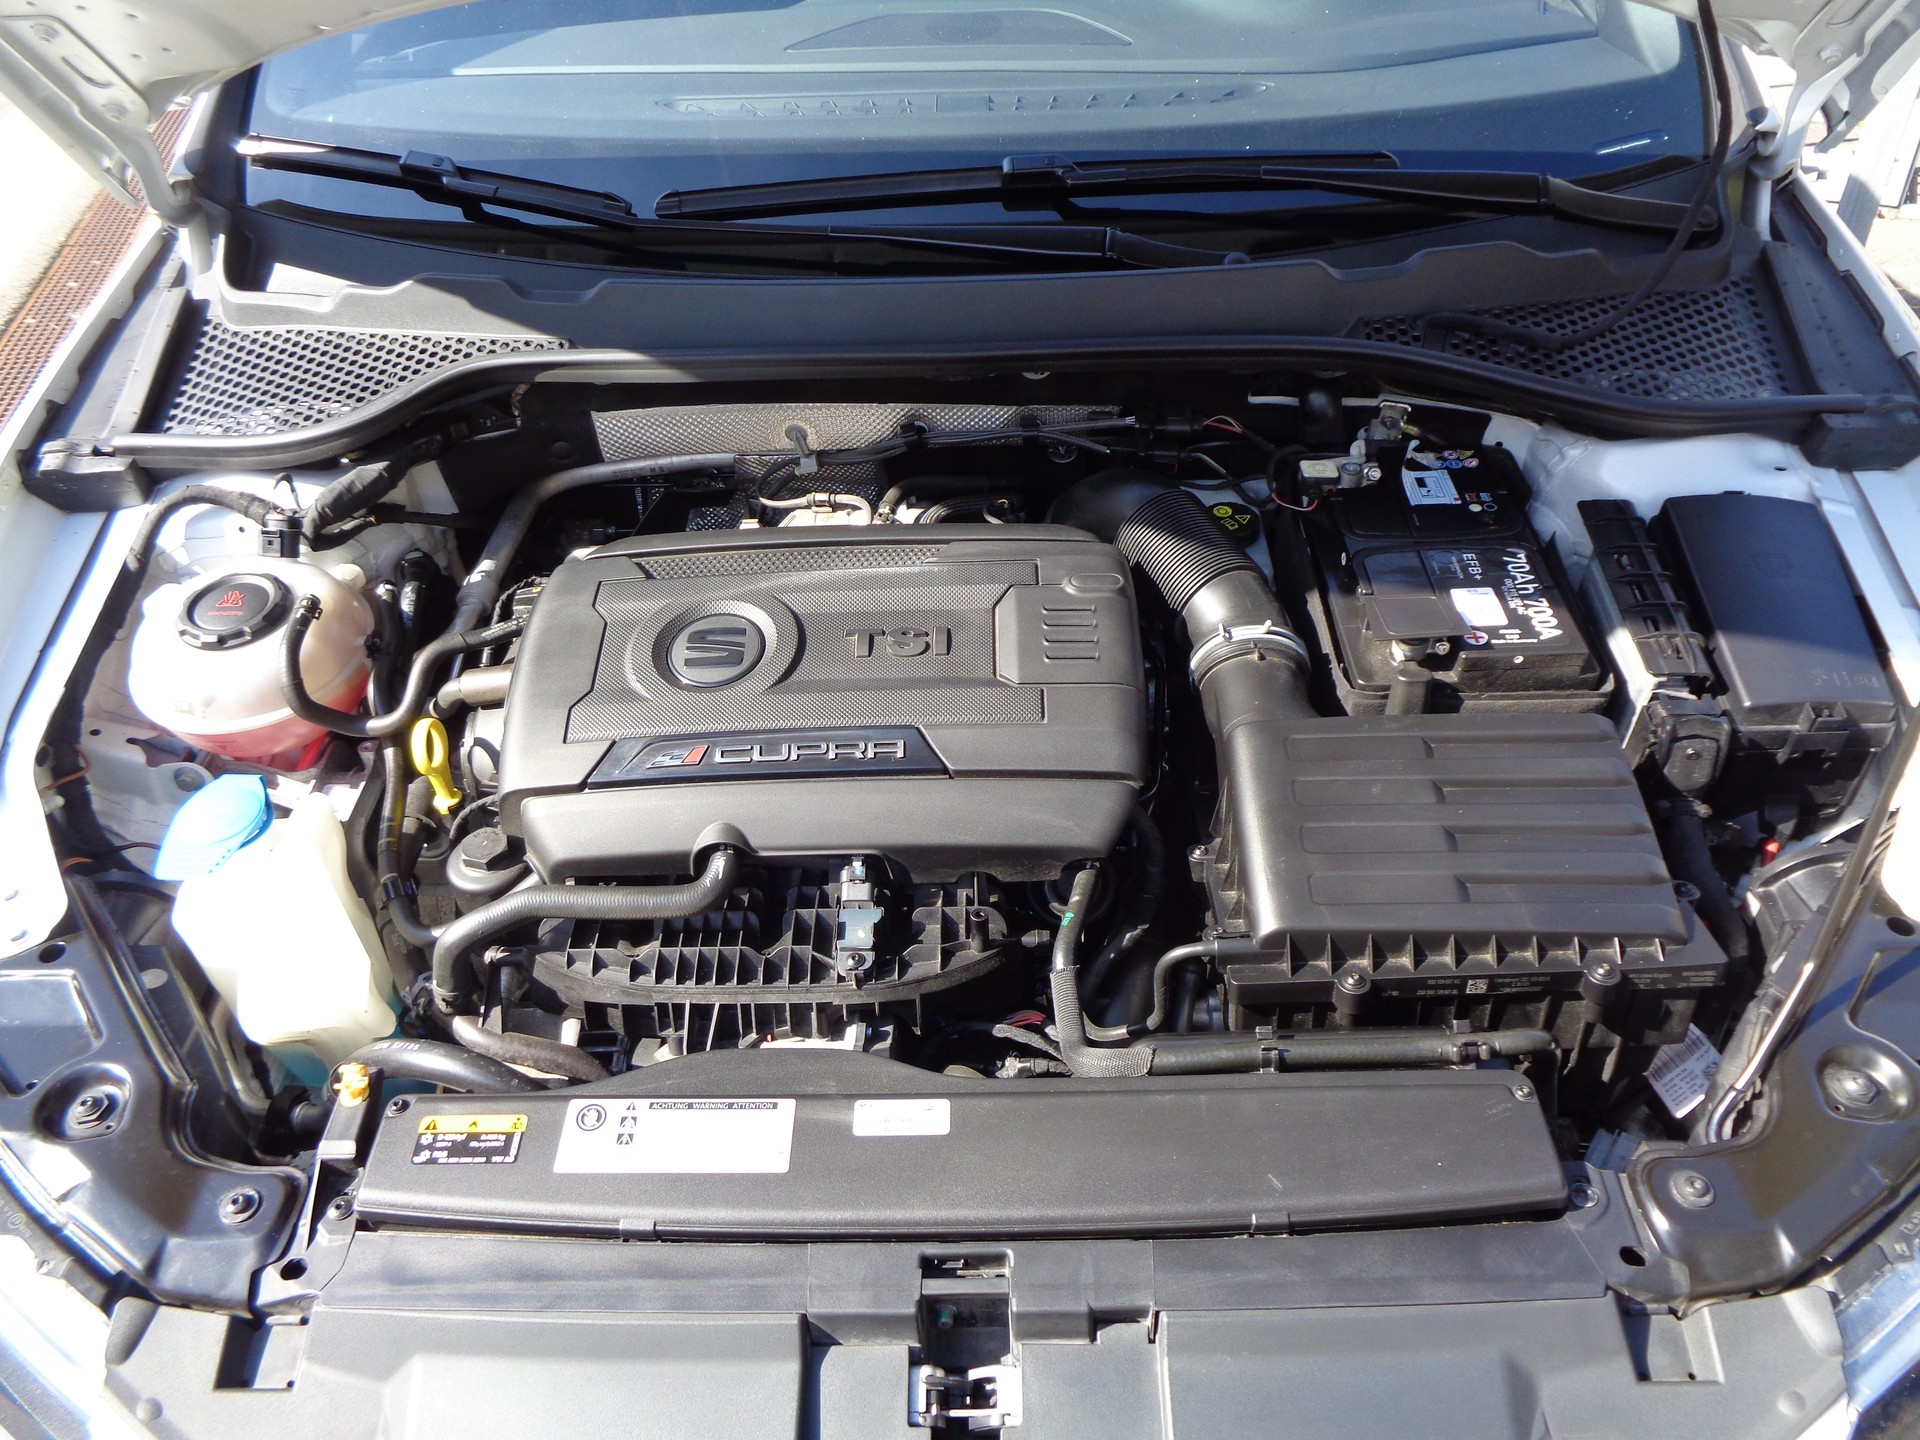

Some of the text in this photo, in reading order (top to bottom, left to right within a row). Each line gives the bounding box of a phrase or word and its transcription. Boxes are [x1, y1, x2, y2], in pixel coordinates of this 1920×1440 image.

[1462, 553, 1483, 581] EFB+
[1503, 551, 1540, 594] 70Ah
[1523, 598, 1564, 640] 700A
[844, 625, 952, 659] TSI
[715, 739, 907, 764] CUPRA
[651, 1102, 774, 1110] ACHTUNG WARNING ATTENTION
